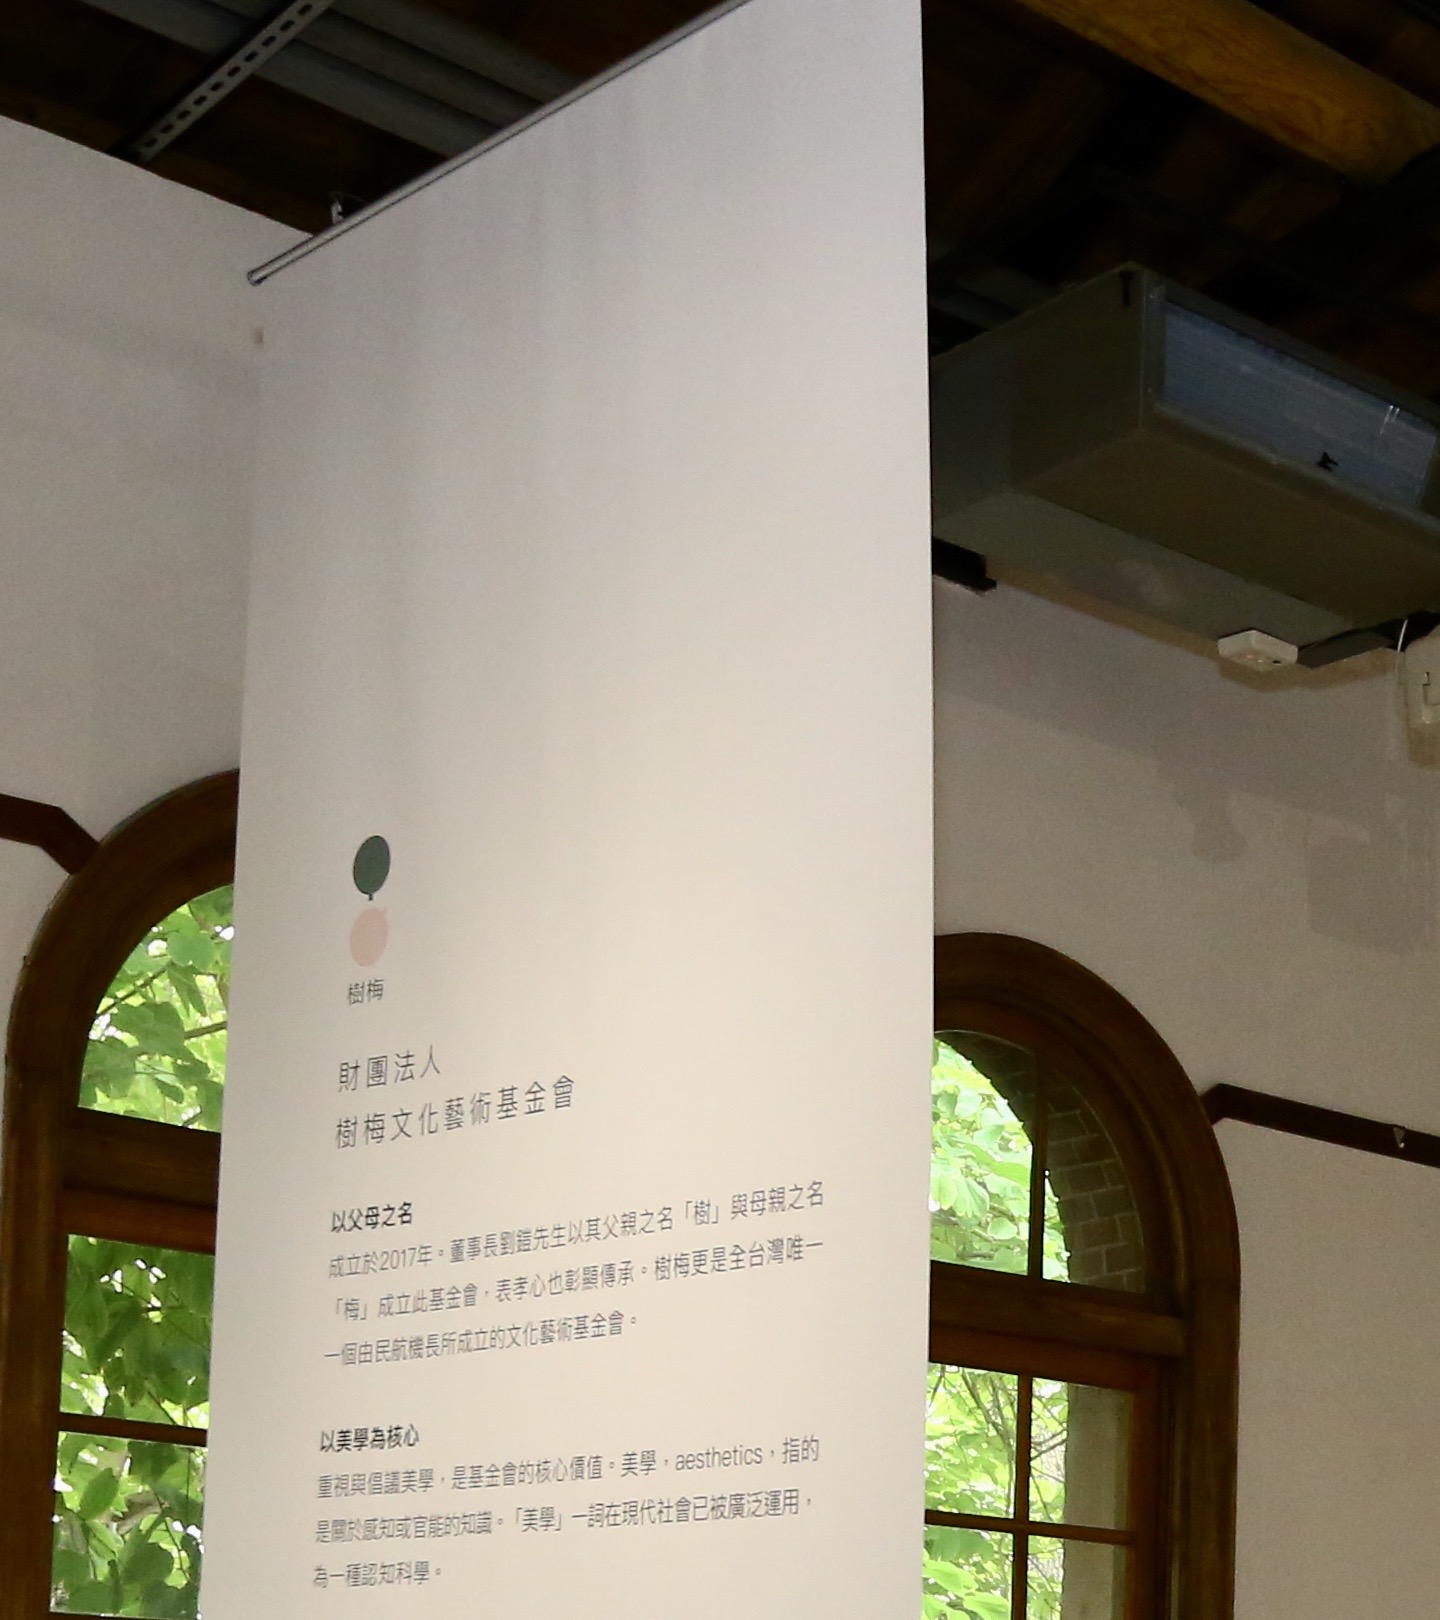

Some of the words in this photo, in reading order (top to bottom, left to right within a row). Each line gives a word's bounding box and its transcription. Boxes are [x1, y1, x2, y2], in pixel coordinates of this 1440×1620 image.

[347, 979, 384, 1006] 樹梅
[338, 1045, 440, 1092] 財團法人
[335, 1075, 574, 1149] 樹梅文化藝術基金會
[330, 1202, 412, 1233] 以父母之名
[320, 1425, 419, 1453] 以美學為核心
[313, 1561, 441, 1588] 為一種認知科學。
